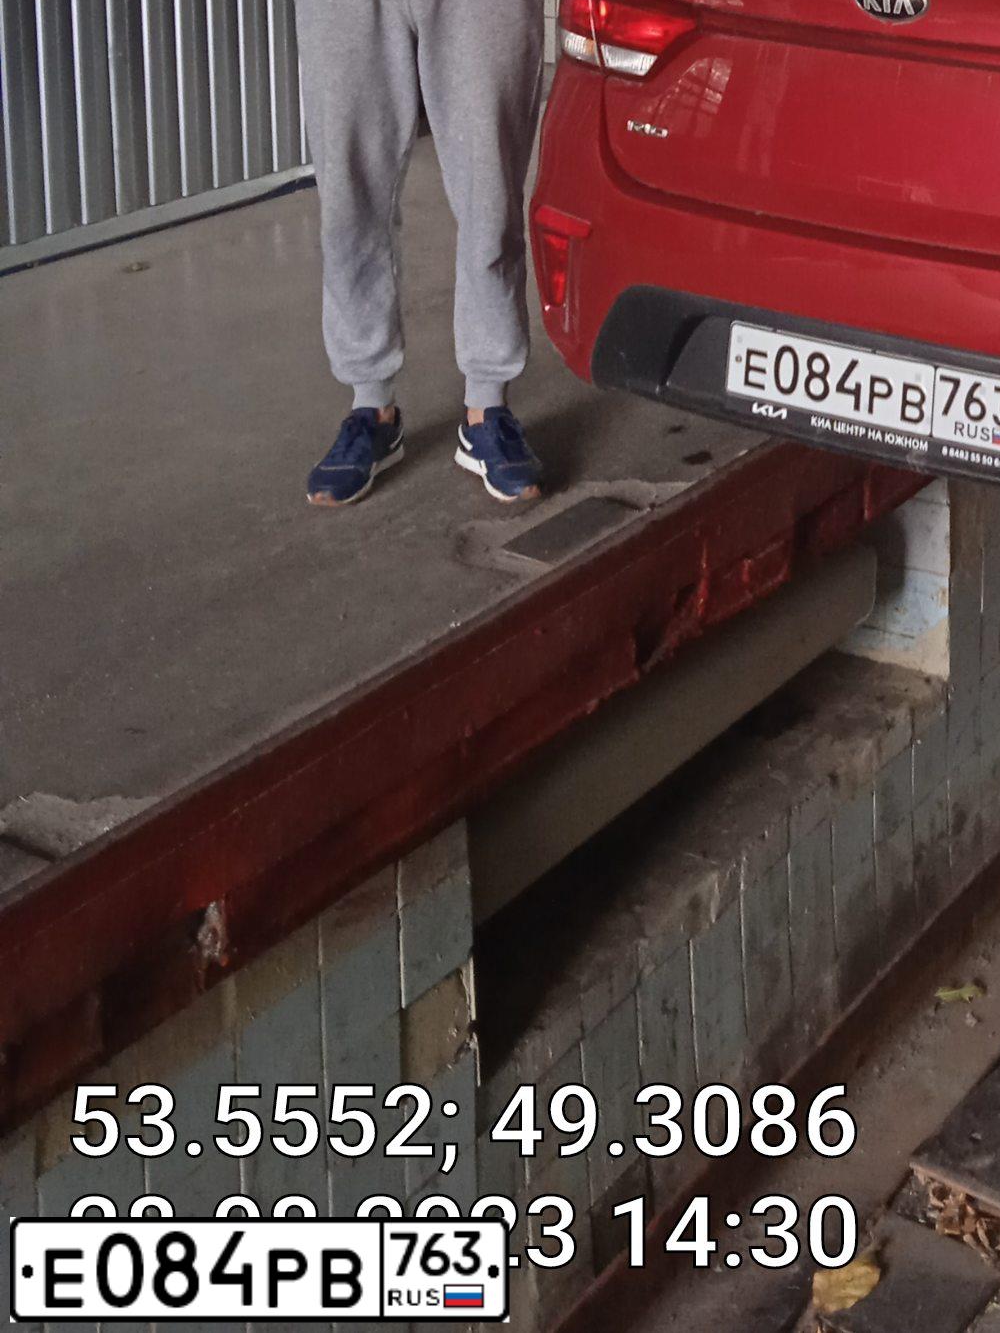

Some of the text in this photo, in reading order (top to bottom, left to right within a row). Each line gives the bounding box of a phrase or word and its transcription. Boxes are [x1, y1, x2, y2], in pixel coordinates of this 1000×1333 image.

[810, 415, 929, 452] КИА ЦЕНТР НА ЮЖНОМ
[953, 421, 991, 442] RUS
